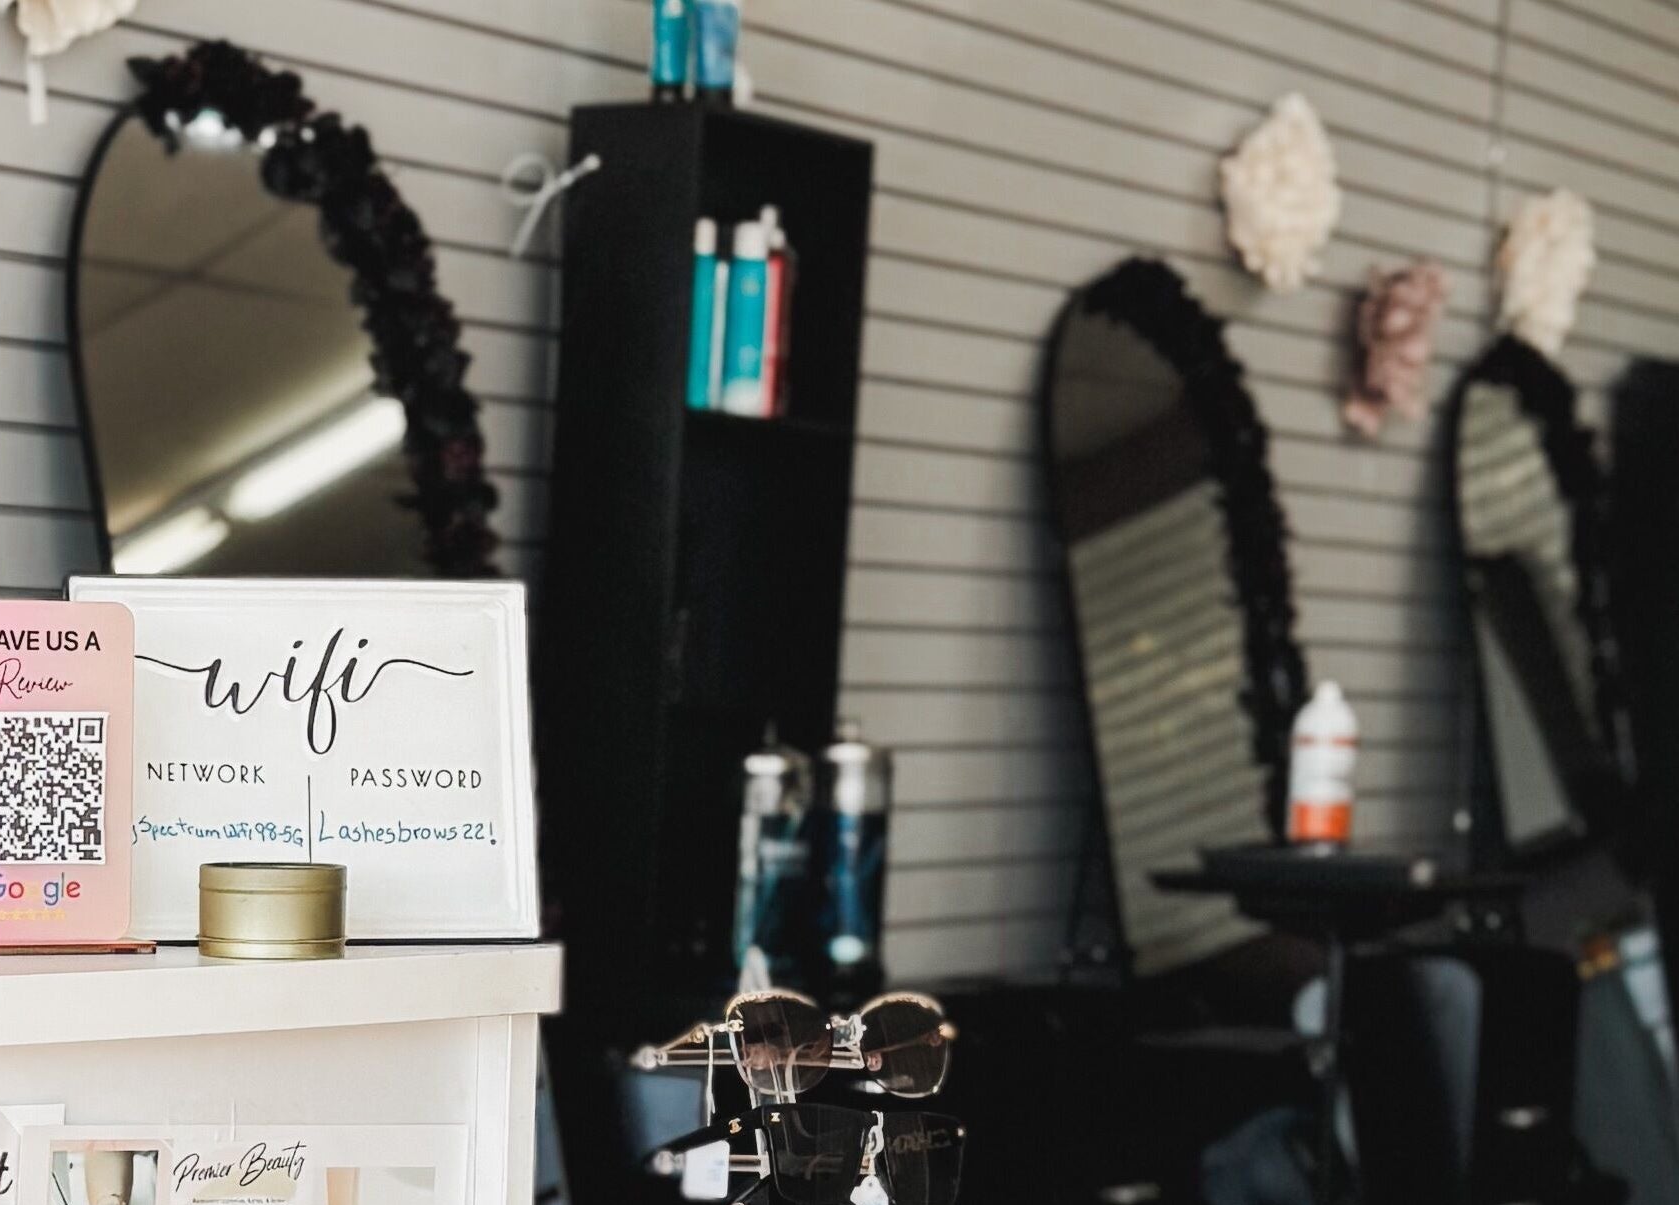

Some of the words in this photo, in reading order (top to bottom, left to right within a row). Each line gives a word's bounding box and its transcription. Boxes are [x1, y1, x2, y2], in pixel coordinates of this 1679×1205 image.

[46, 630, 79, 651] US
[84, 631, 101, 651] A
[147, 762, 266, 785] NETWORK
[350, 767, 483, 790] PASSWORD
[173, 1153, 235, 1193] Premier
[239, 1140, 307, 1187] Beauty
